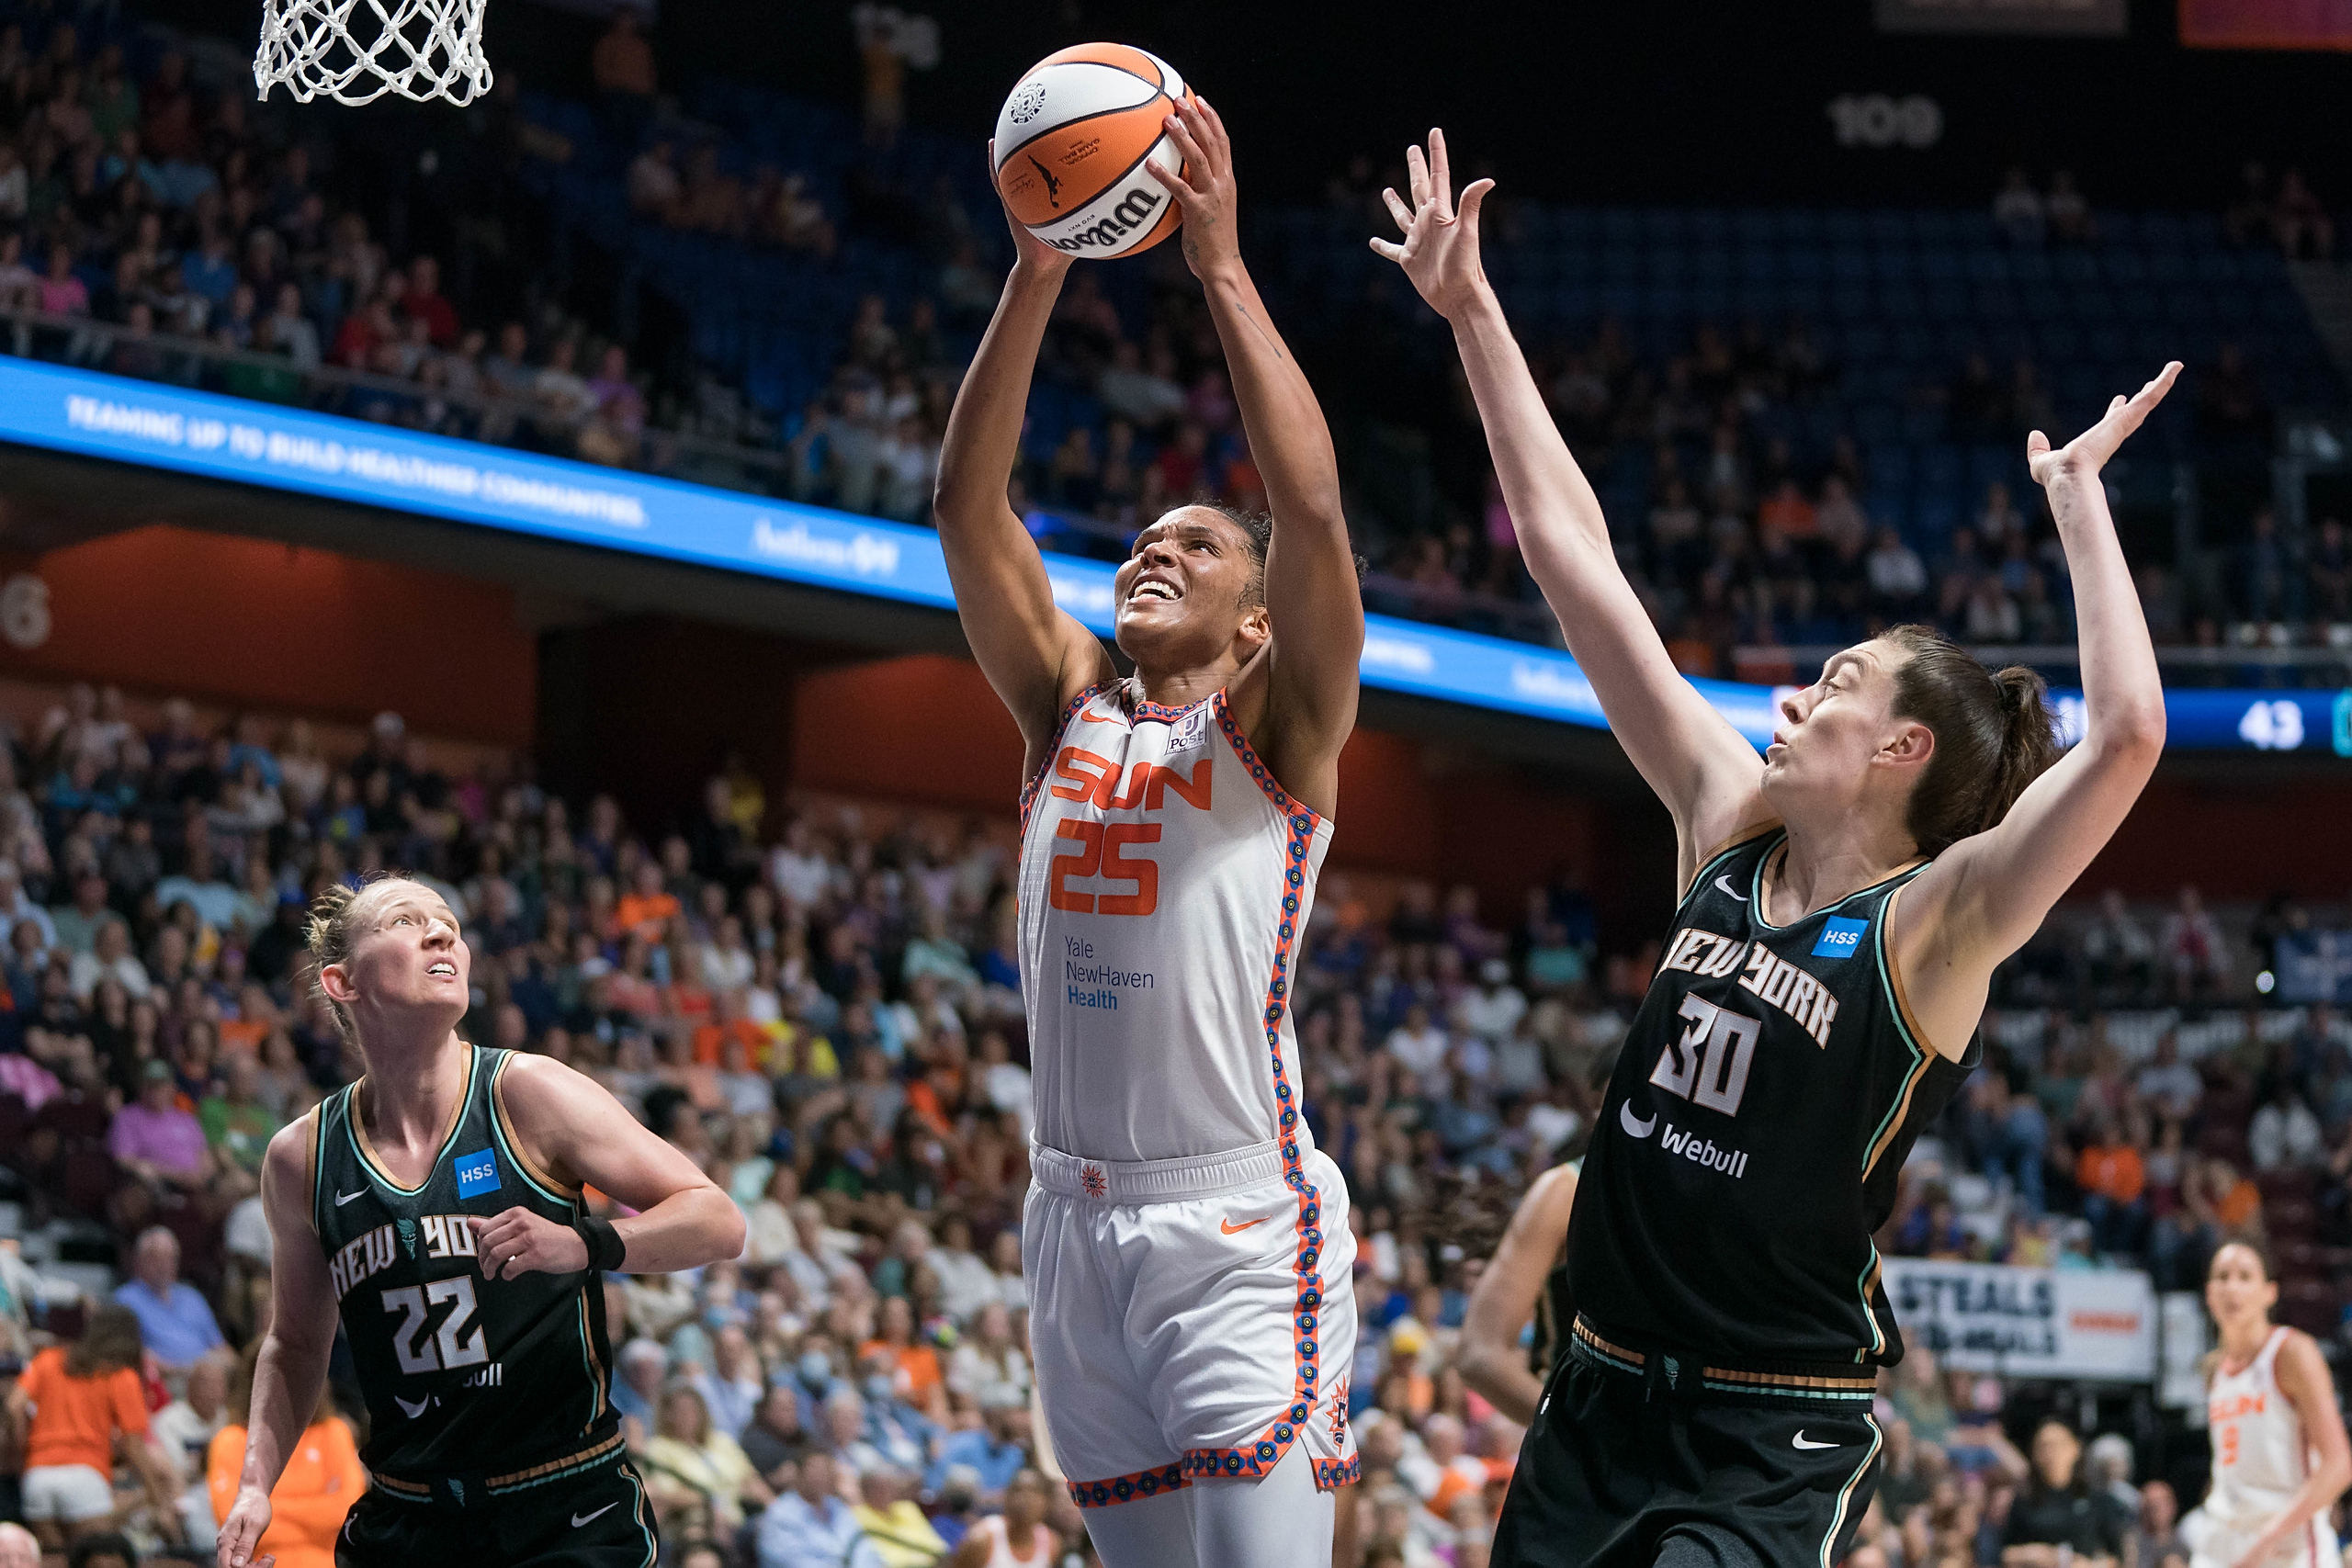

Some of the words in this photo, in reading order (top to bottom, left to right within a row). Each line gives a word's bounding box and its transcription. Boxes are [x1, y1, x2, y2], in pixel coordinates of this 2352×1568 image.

[1039, 187, 1163, 250] Wilson
[1068, 220, 1081, 232] NXT
[1082, 213, 1095, 225] EVO
[187, 419, 227, 450] UP
[229, 424, 265, 458] TO
[2238, 699, 2304, 750] 43
[1051, 746, 1212, 811] SUN
[1050, 818, 1162, 916] 25
[1065, 936, 1093, 959] Yale
[1823, 930, 1859, 945] HSS
[1066, 962, 1154, 989] NewHaven
[1068, 986, 1117, 1010] Health
[1737, 941, 1839, 1050] YORK
[1649, 991, 1761, 1117] 30
[460, 1163, 494, 1183] HSS
[1660, 1122, 1749, 1179] Webull
[329, 1223, 397, 1304] NEW
[421, 1214, 486, 1258] YO
[380, 1275, 489, 1375] 22
